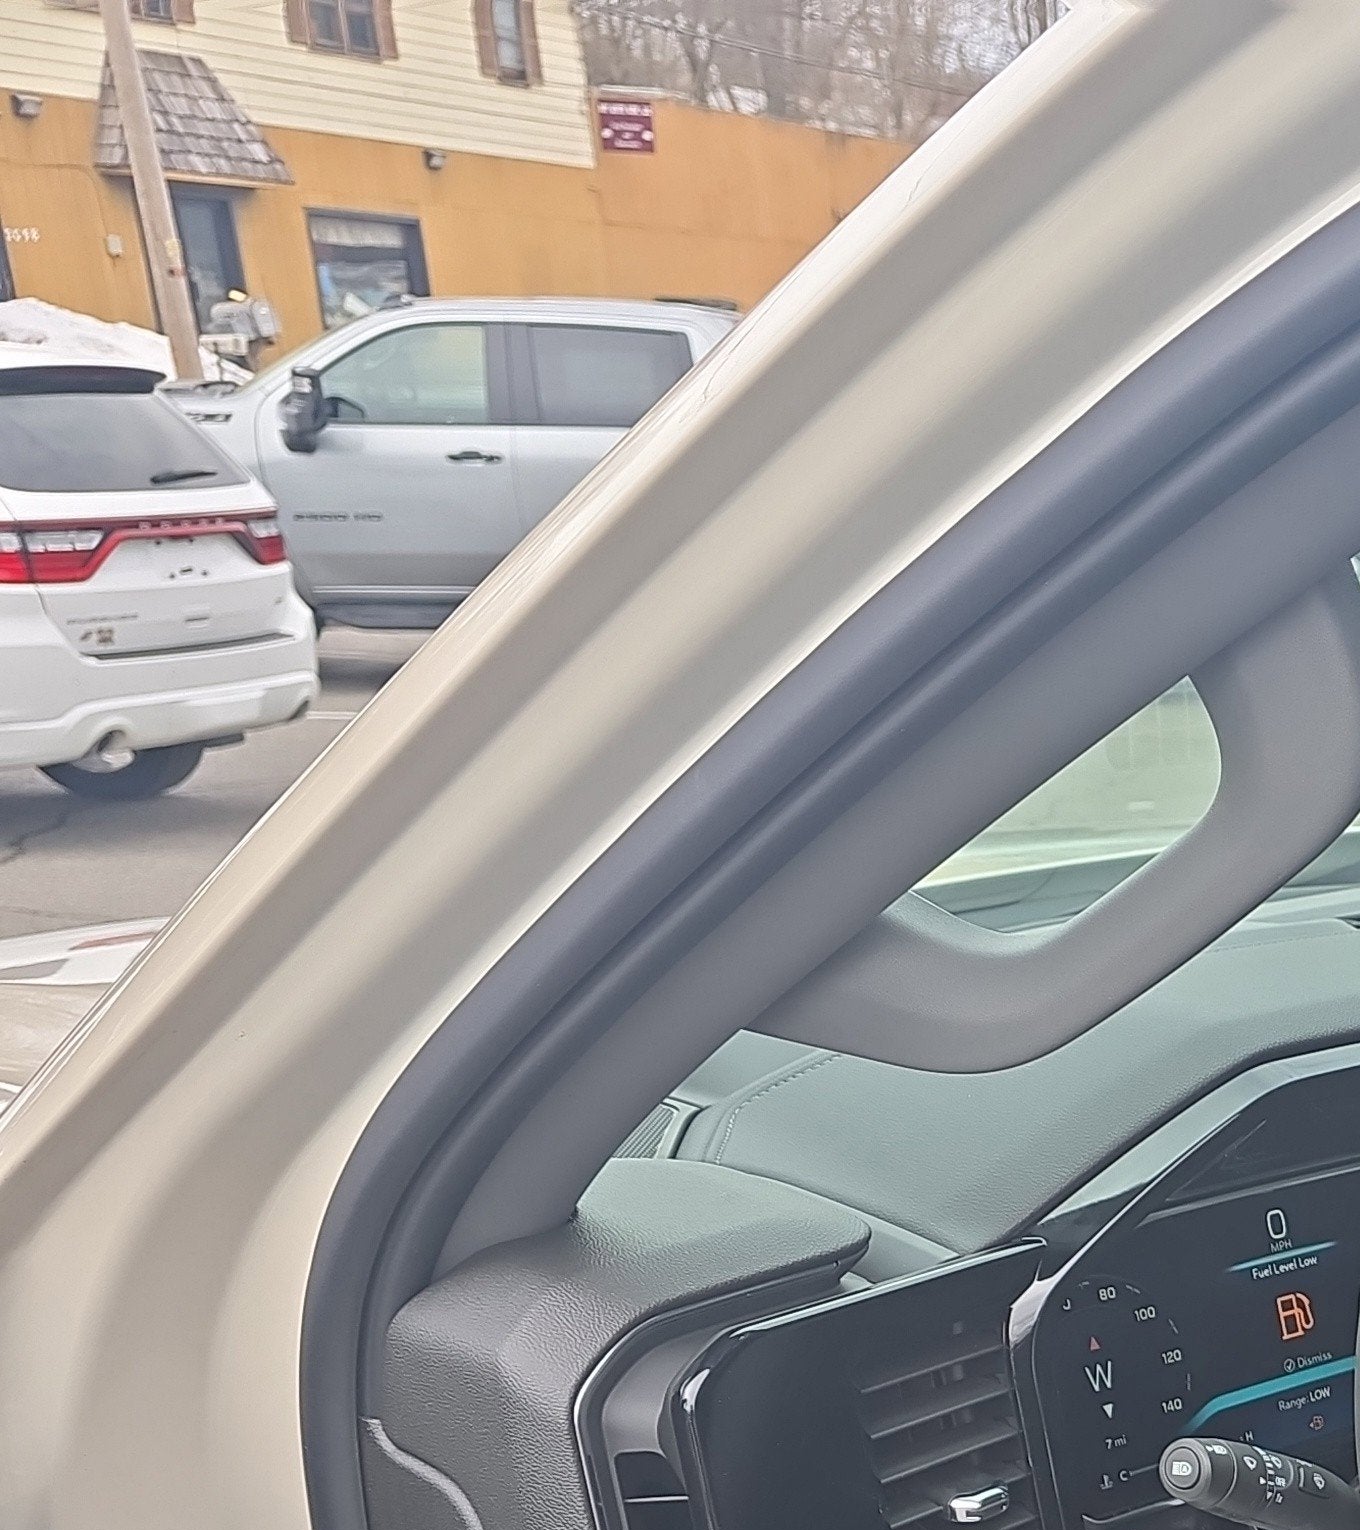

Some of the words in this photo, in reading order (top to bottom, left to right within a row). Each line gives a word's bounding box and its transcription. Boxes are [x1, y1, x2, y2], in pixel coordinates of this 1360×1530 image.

[1266, 1209, 1287, 1239] 0
[1270, 1238, 1293, 1252] MPH
[1251, 1267, 1273, 1280] Fuel
[1273, 1260, 1298, 1272] Level
[1298, 1255, 1318, 1268] Low
[1098, 1286, 1117, 1301] 80
[1133, 1306, 1156, 1322] 100
[1161, 1348, 1182, 1365] 120
[1296, 1351, 1333, 1370] Dismiss
[1084, 1360, 1112, 1392] W
[1308, 1386, 1331, 1403] LOW
[1161, 1397, 1183, 1414] 140
